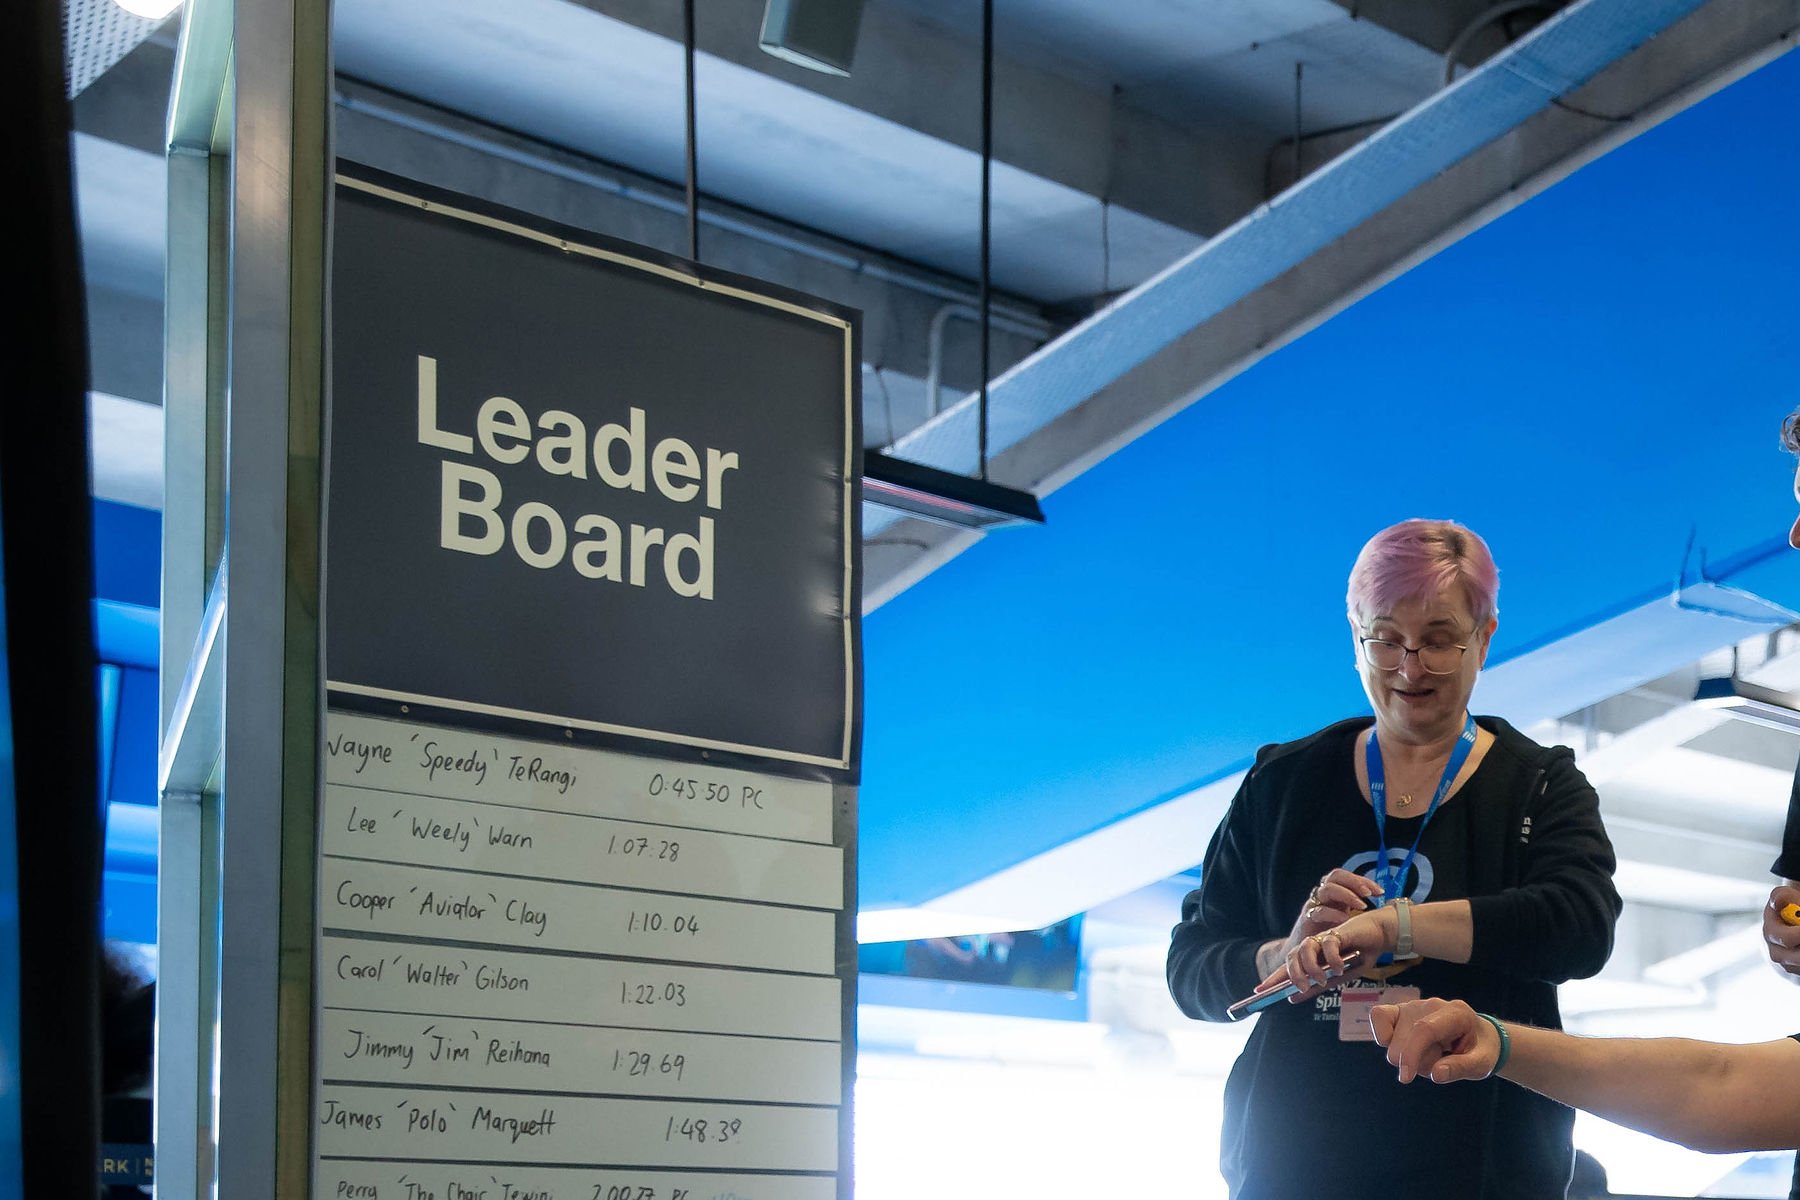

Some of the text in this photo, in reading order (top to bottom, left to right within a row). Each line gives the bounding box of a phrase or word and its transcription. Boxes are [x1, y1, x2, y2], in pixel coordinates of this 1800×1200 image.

[418, 355, 738, 510] Leader
[441, 460, 714, 600] Board
[742, 786, 763, 809] PC
[347, 806, 376, 833] Lee
[336, 880, 395, 920] Cooper
[505, 899, 547, 936] Clay
[337, 954, 384, 982] Carol
[475, 965, 529, 991] Gilson
[344, 1029, 414, 1069] Jimmy
[321, 1100, 382, 1130] James
